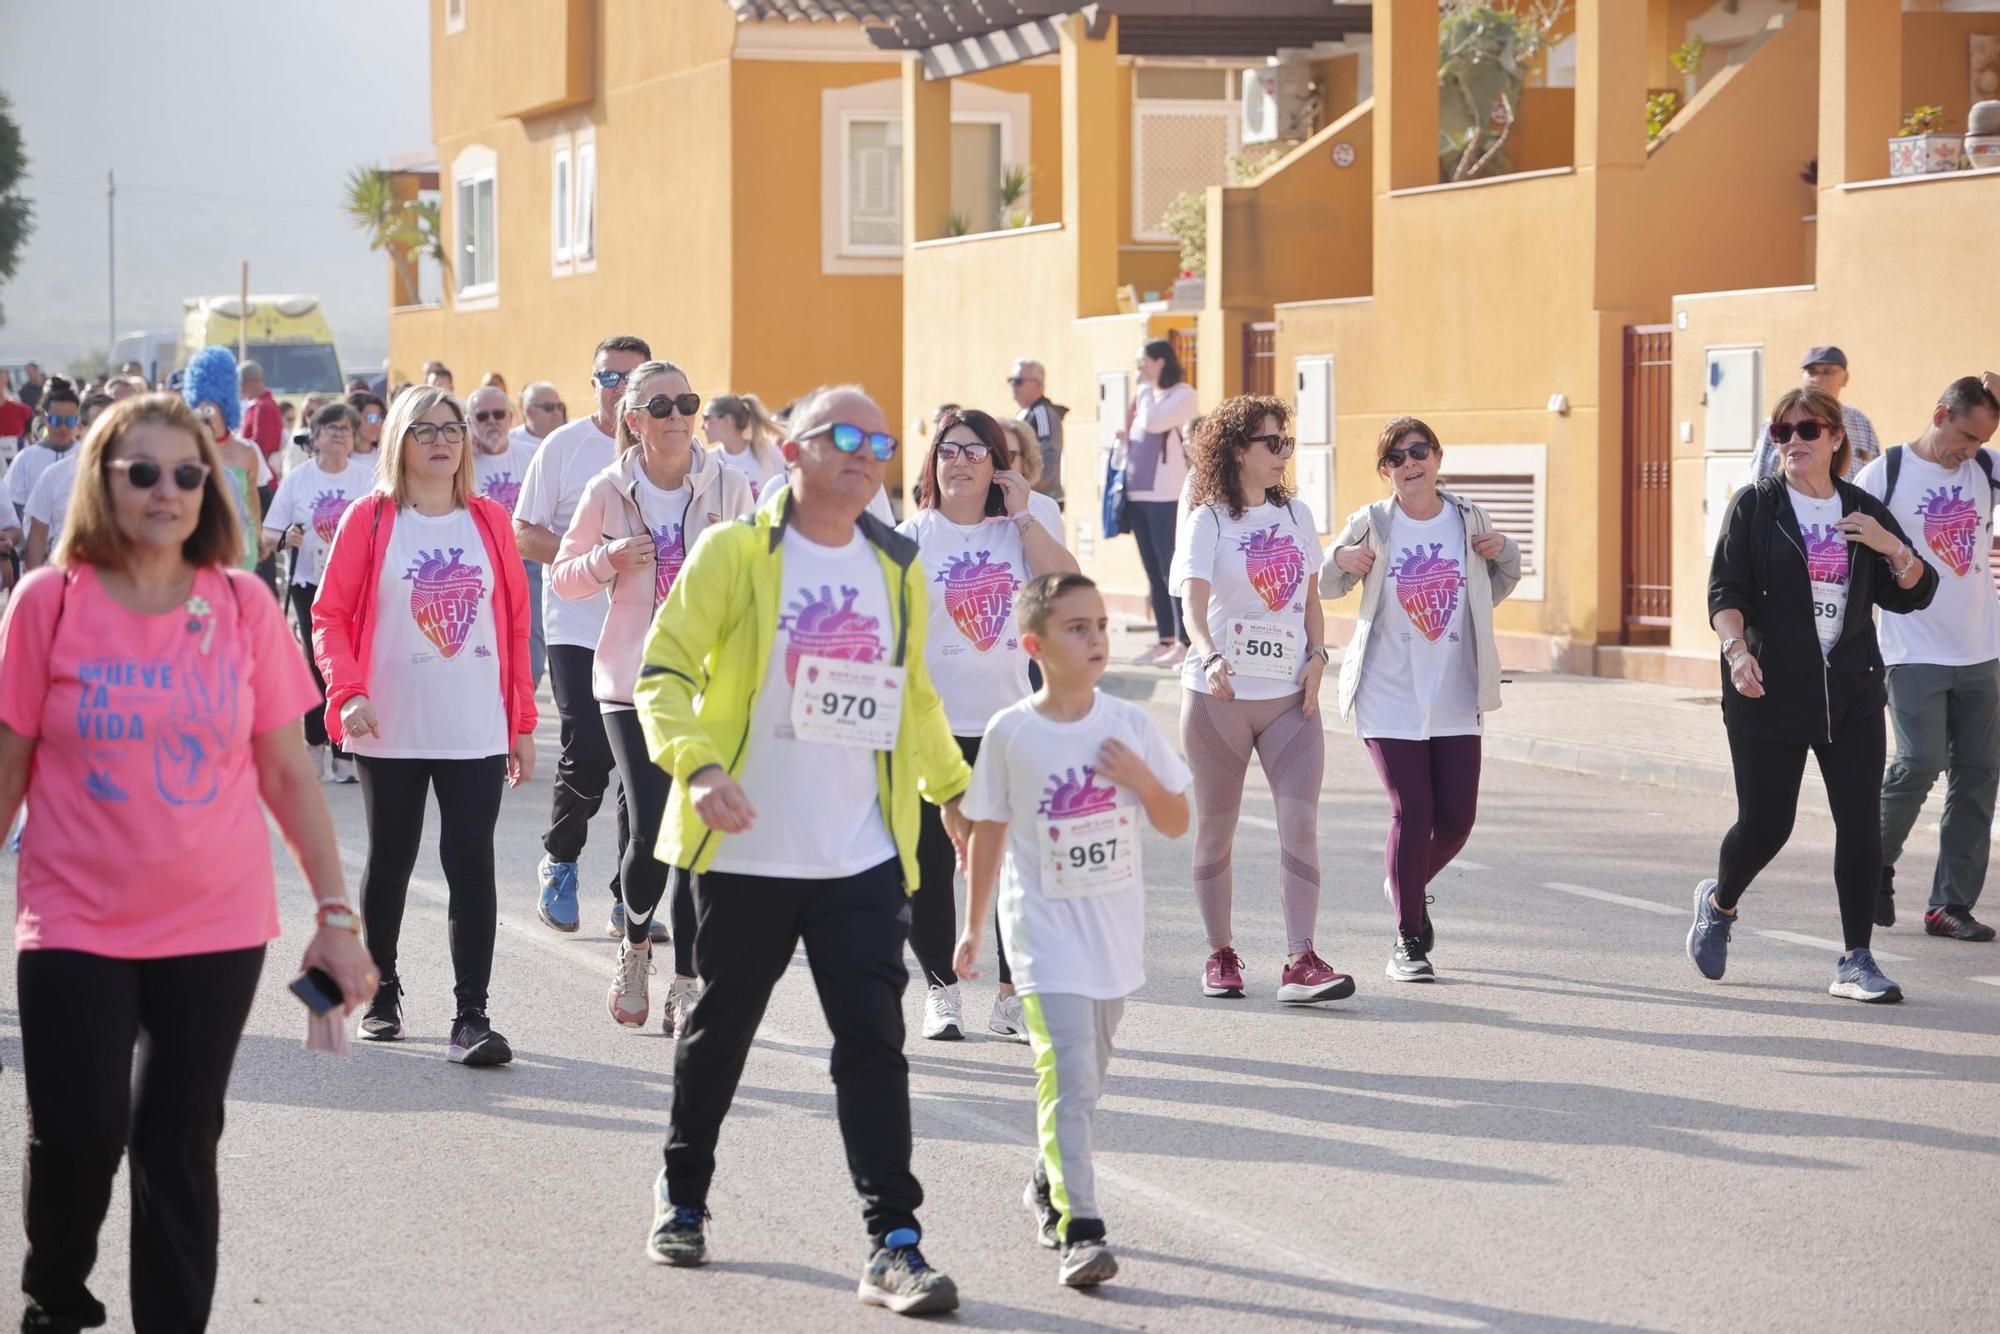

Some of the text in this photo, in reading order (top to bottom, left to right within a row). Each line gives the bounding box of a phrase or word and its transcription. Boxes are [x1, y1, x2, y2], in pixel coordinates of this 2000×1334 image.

[1931, 528, 1977, 557] MUEVE
[1939, 546, 1973, 569] VIDA
[1253, 562, 1304, 594] MUEVE
[1260, 582, 1298, 610] VIDA
[1405, 589, 1458, 620] MUEVE
[416, 600, 478, 633] MUEVE
[952, 594, 1012, 629] MUEVE
[1410, 609, 1453, 633] VIDA
[423, 621, 470, 648] VIDA
[960, 615, 1006, 642] VIDA
[1246, 640, 1283, 658] 503
[78, 662, 173, 689] MUEVE
[821, 692, 876, 720] 970
[77, 713, 145, 741] VIDA
[1069, 838, 1118, 868] 967
